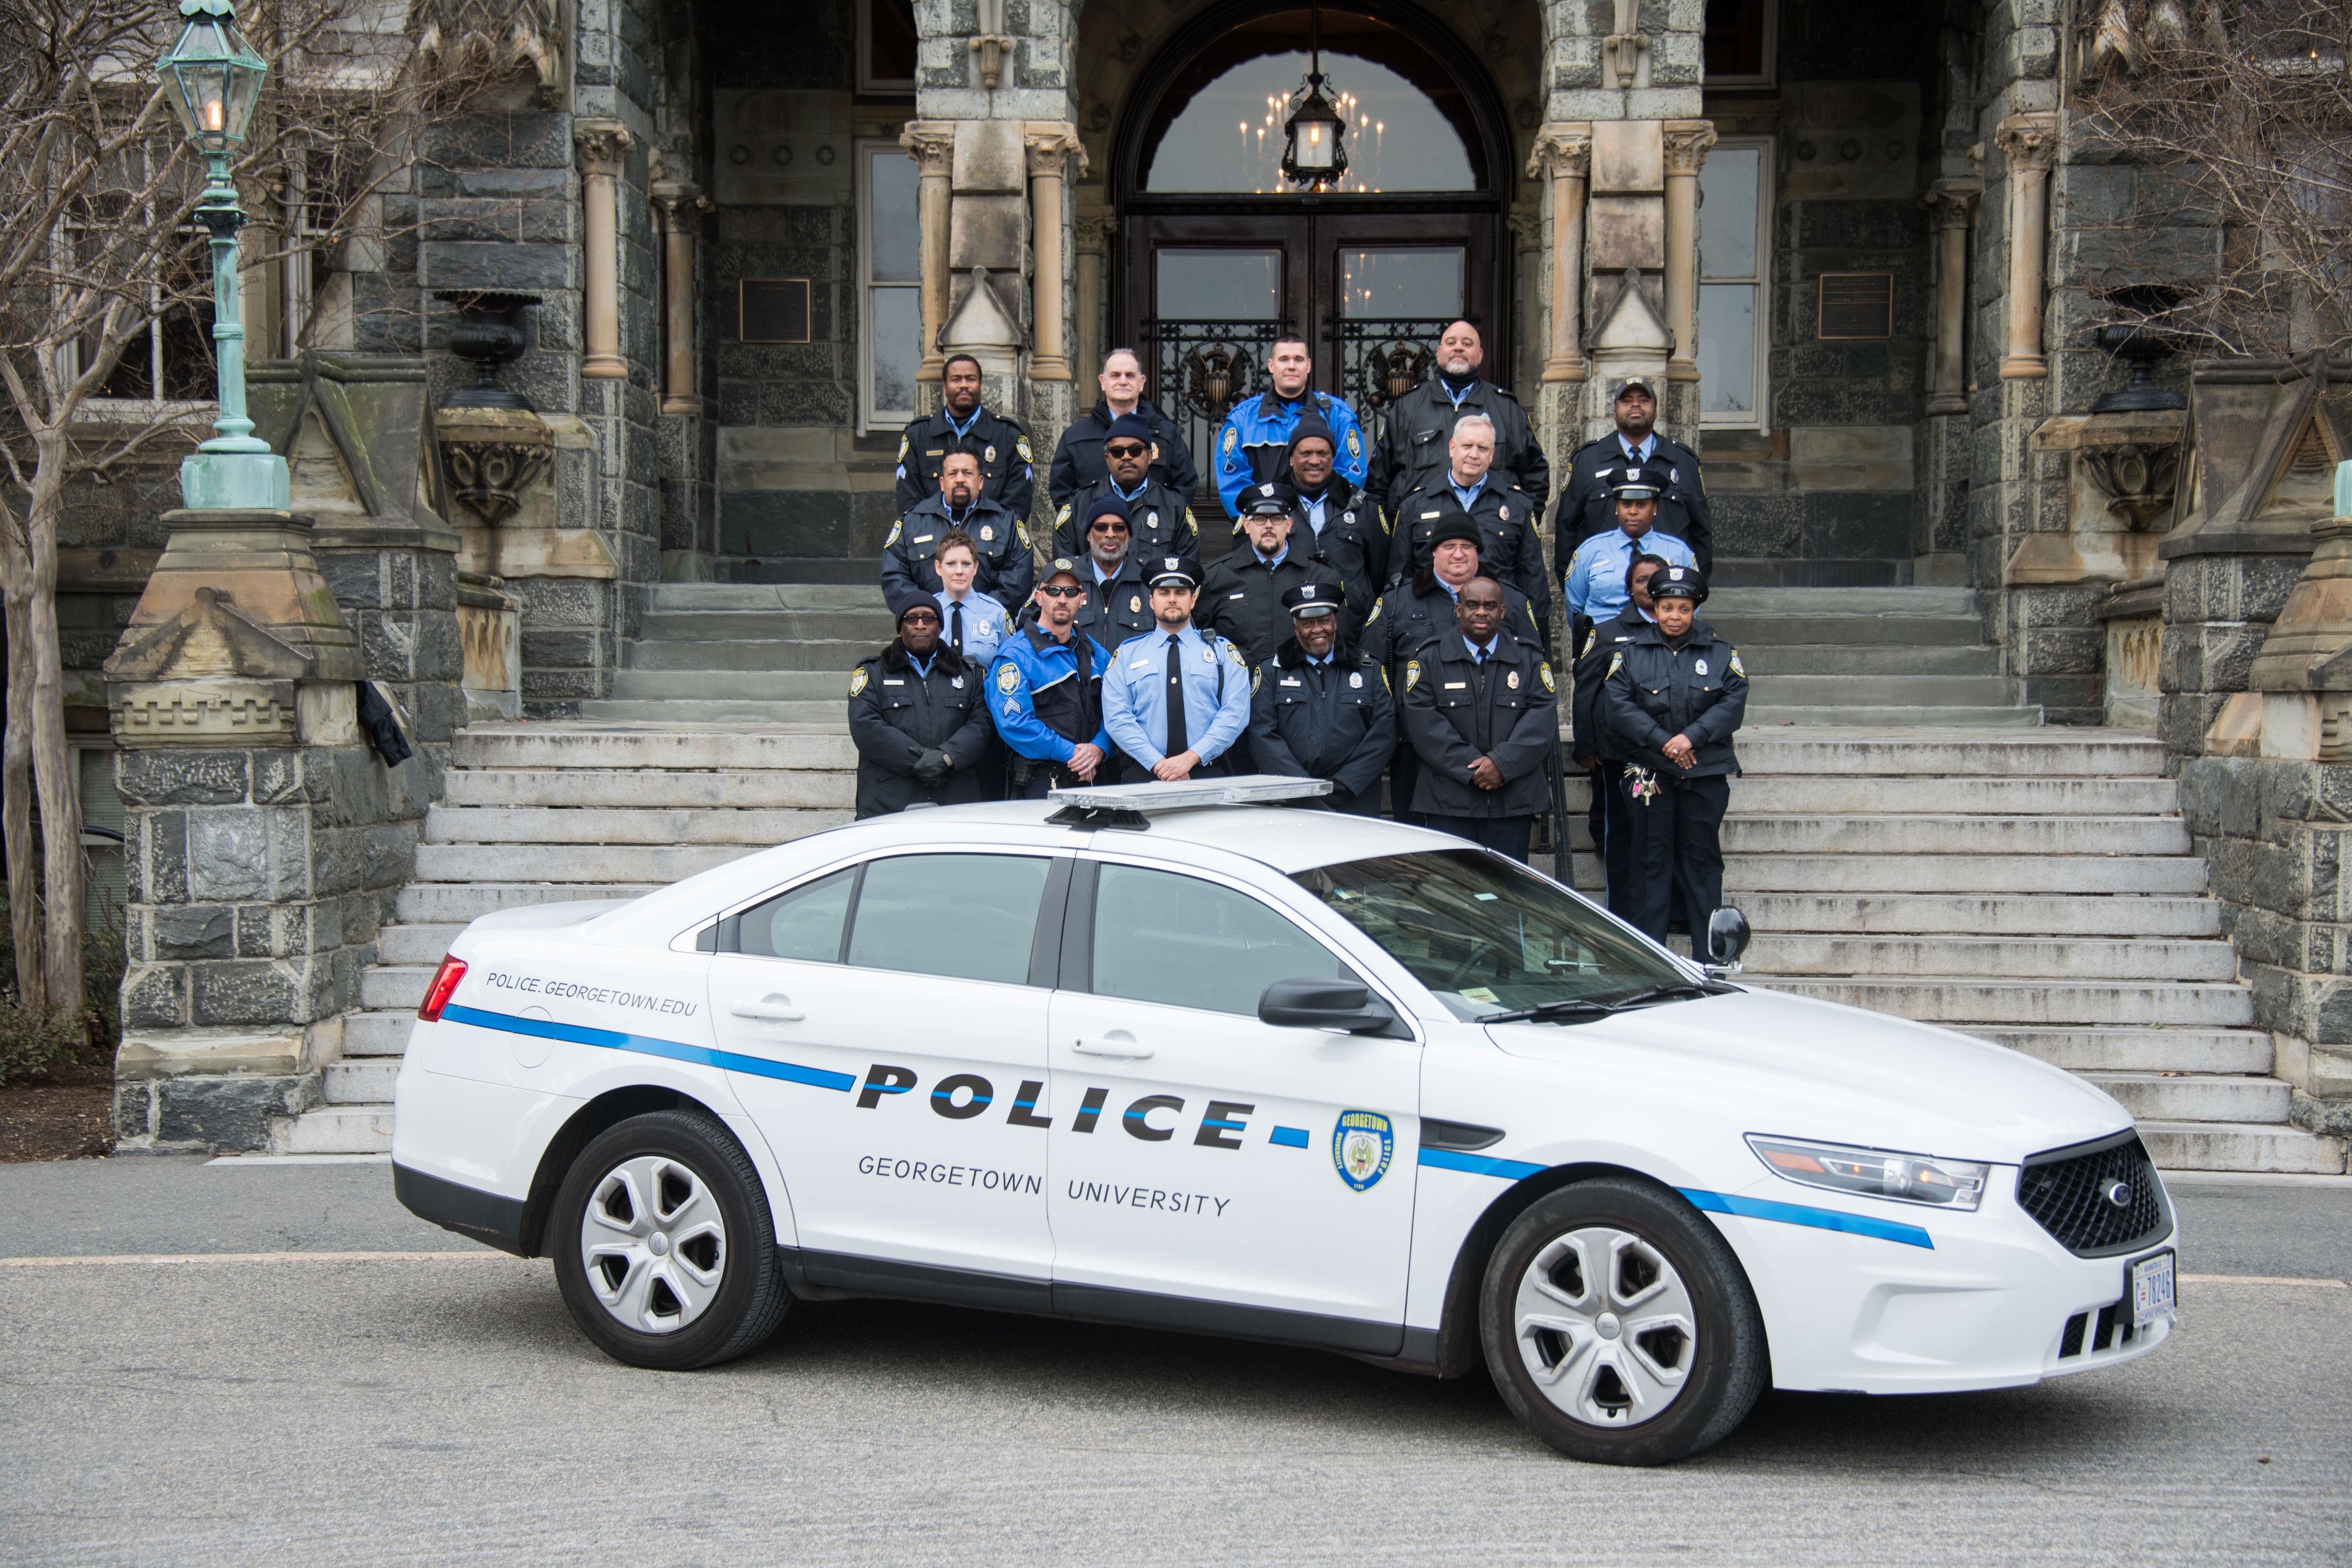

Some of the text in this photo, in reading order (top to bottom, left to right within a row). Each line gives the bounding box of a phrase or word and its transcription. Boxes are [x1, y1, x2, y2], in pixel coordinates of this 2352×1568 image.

[856, 1063, 1255, 1150] POLICE
[1342, 1113, 1388, 1132] GEORGETOWN
[1335, 1132, 1343, 1170] UNIVERSITY
[1377, 1139, 1391, 1175] POLICE
[858, 1156, 1231, 1217] GEORGETOWN UNIVERSITY
[2148, 1270, 2170, 1307] 78246
